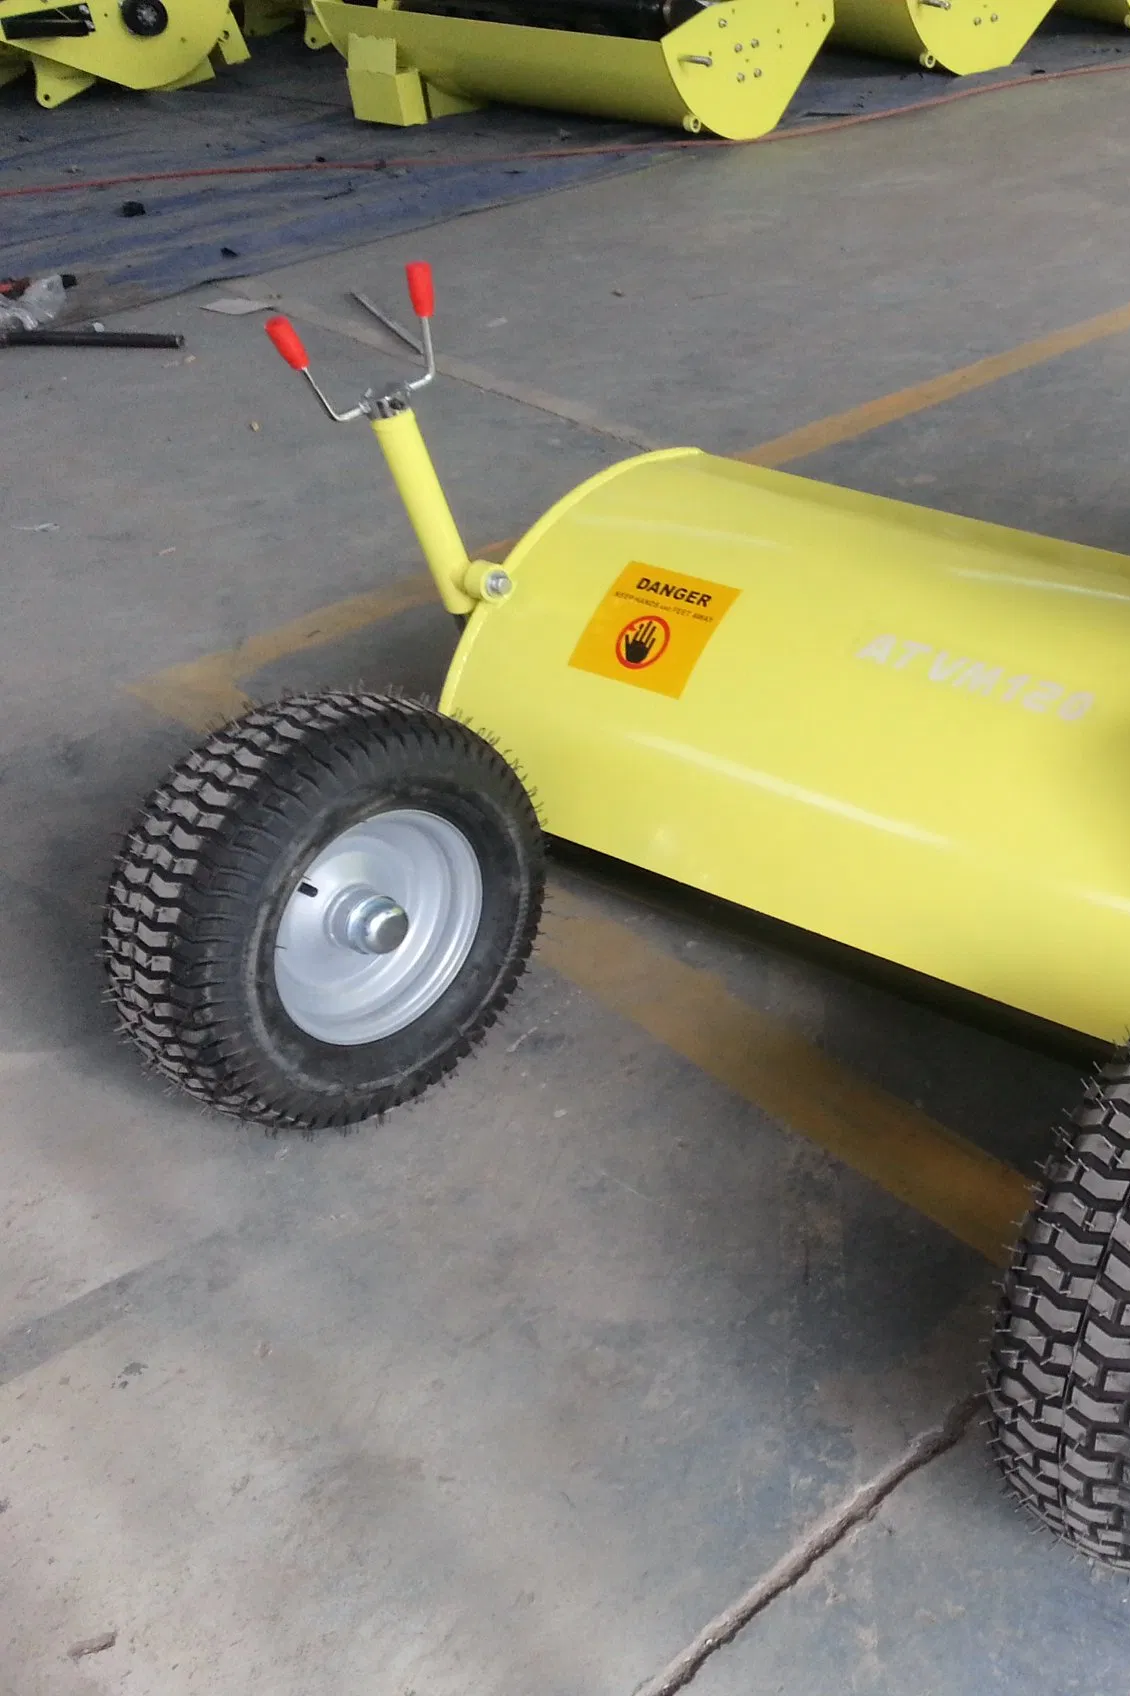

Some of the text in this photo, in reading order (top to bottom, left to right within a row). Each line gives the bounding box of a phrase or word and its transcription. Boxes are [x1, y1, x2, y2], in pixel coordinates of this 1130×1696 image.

[635, 596, 660, 608] HANDS
[672, 606, 692, 616] FEET
[636, 577, 712, 607] DANGER
[854, 632, 1095, 721] ATVM120
